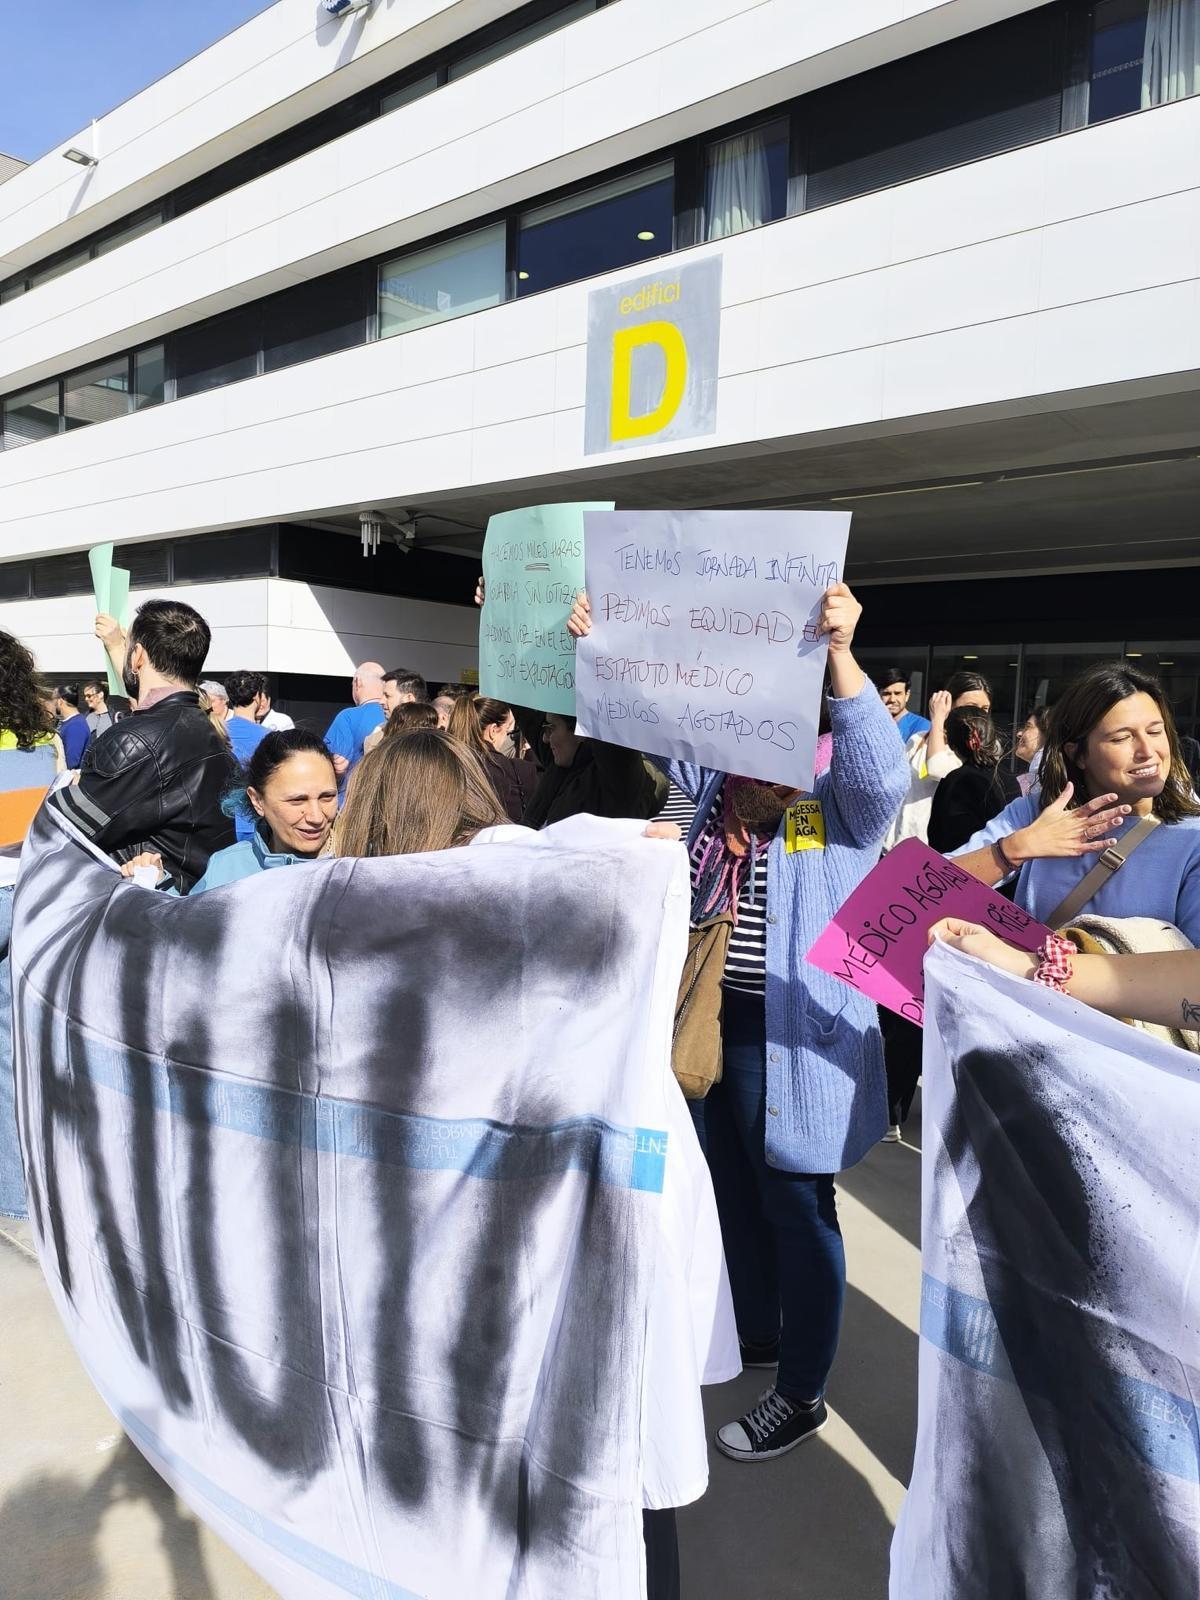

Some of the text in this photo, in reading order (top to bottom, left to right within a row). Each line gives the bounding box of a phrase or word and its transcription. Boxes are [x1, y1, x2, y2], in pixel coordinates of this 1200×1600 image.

[619, 275, 681, 316] edifici
[610, 320, 689, 442] D
[615, 544, 681, 576] TENEMOS
[696, 550, 757, 581] JORNADA
[600, 592, 671, 629] PEDIMOS
[689, 607, 795, 643] EQUIDAD
[595, 651, 754, 696] ESTATUTO MÉDICO
[597, 692, 799, 751] MEDICOS AGOTADOS
[795, 826, 818, 837] AGA
[833, 861, 972, 988] MÉDICO AGOTAD
